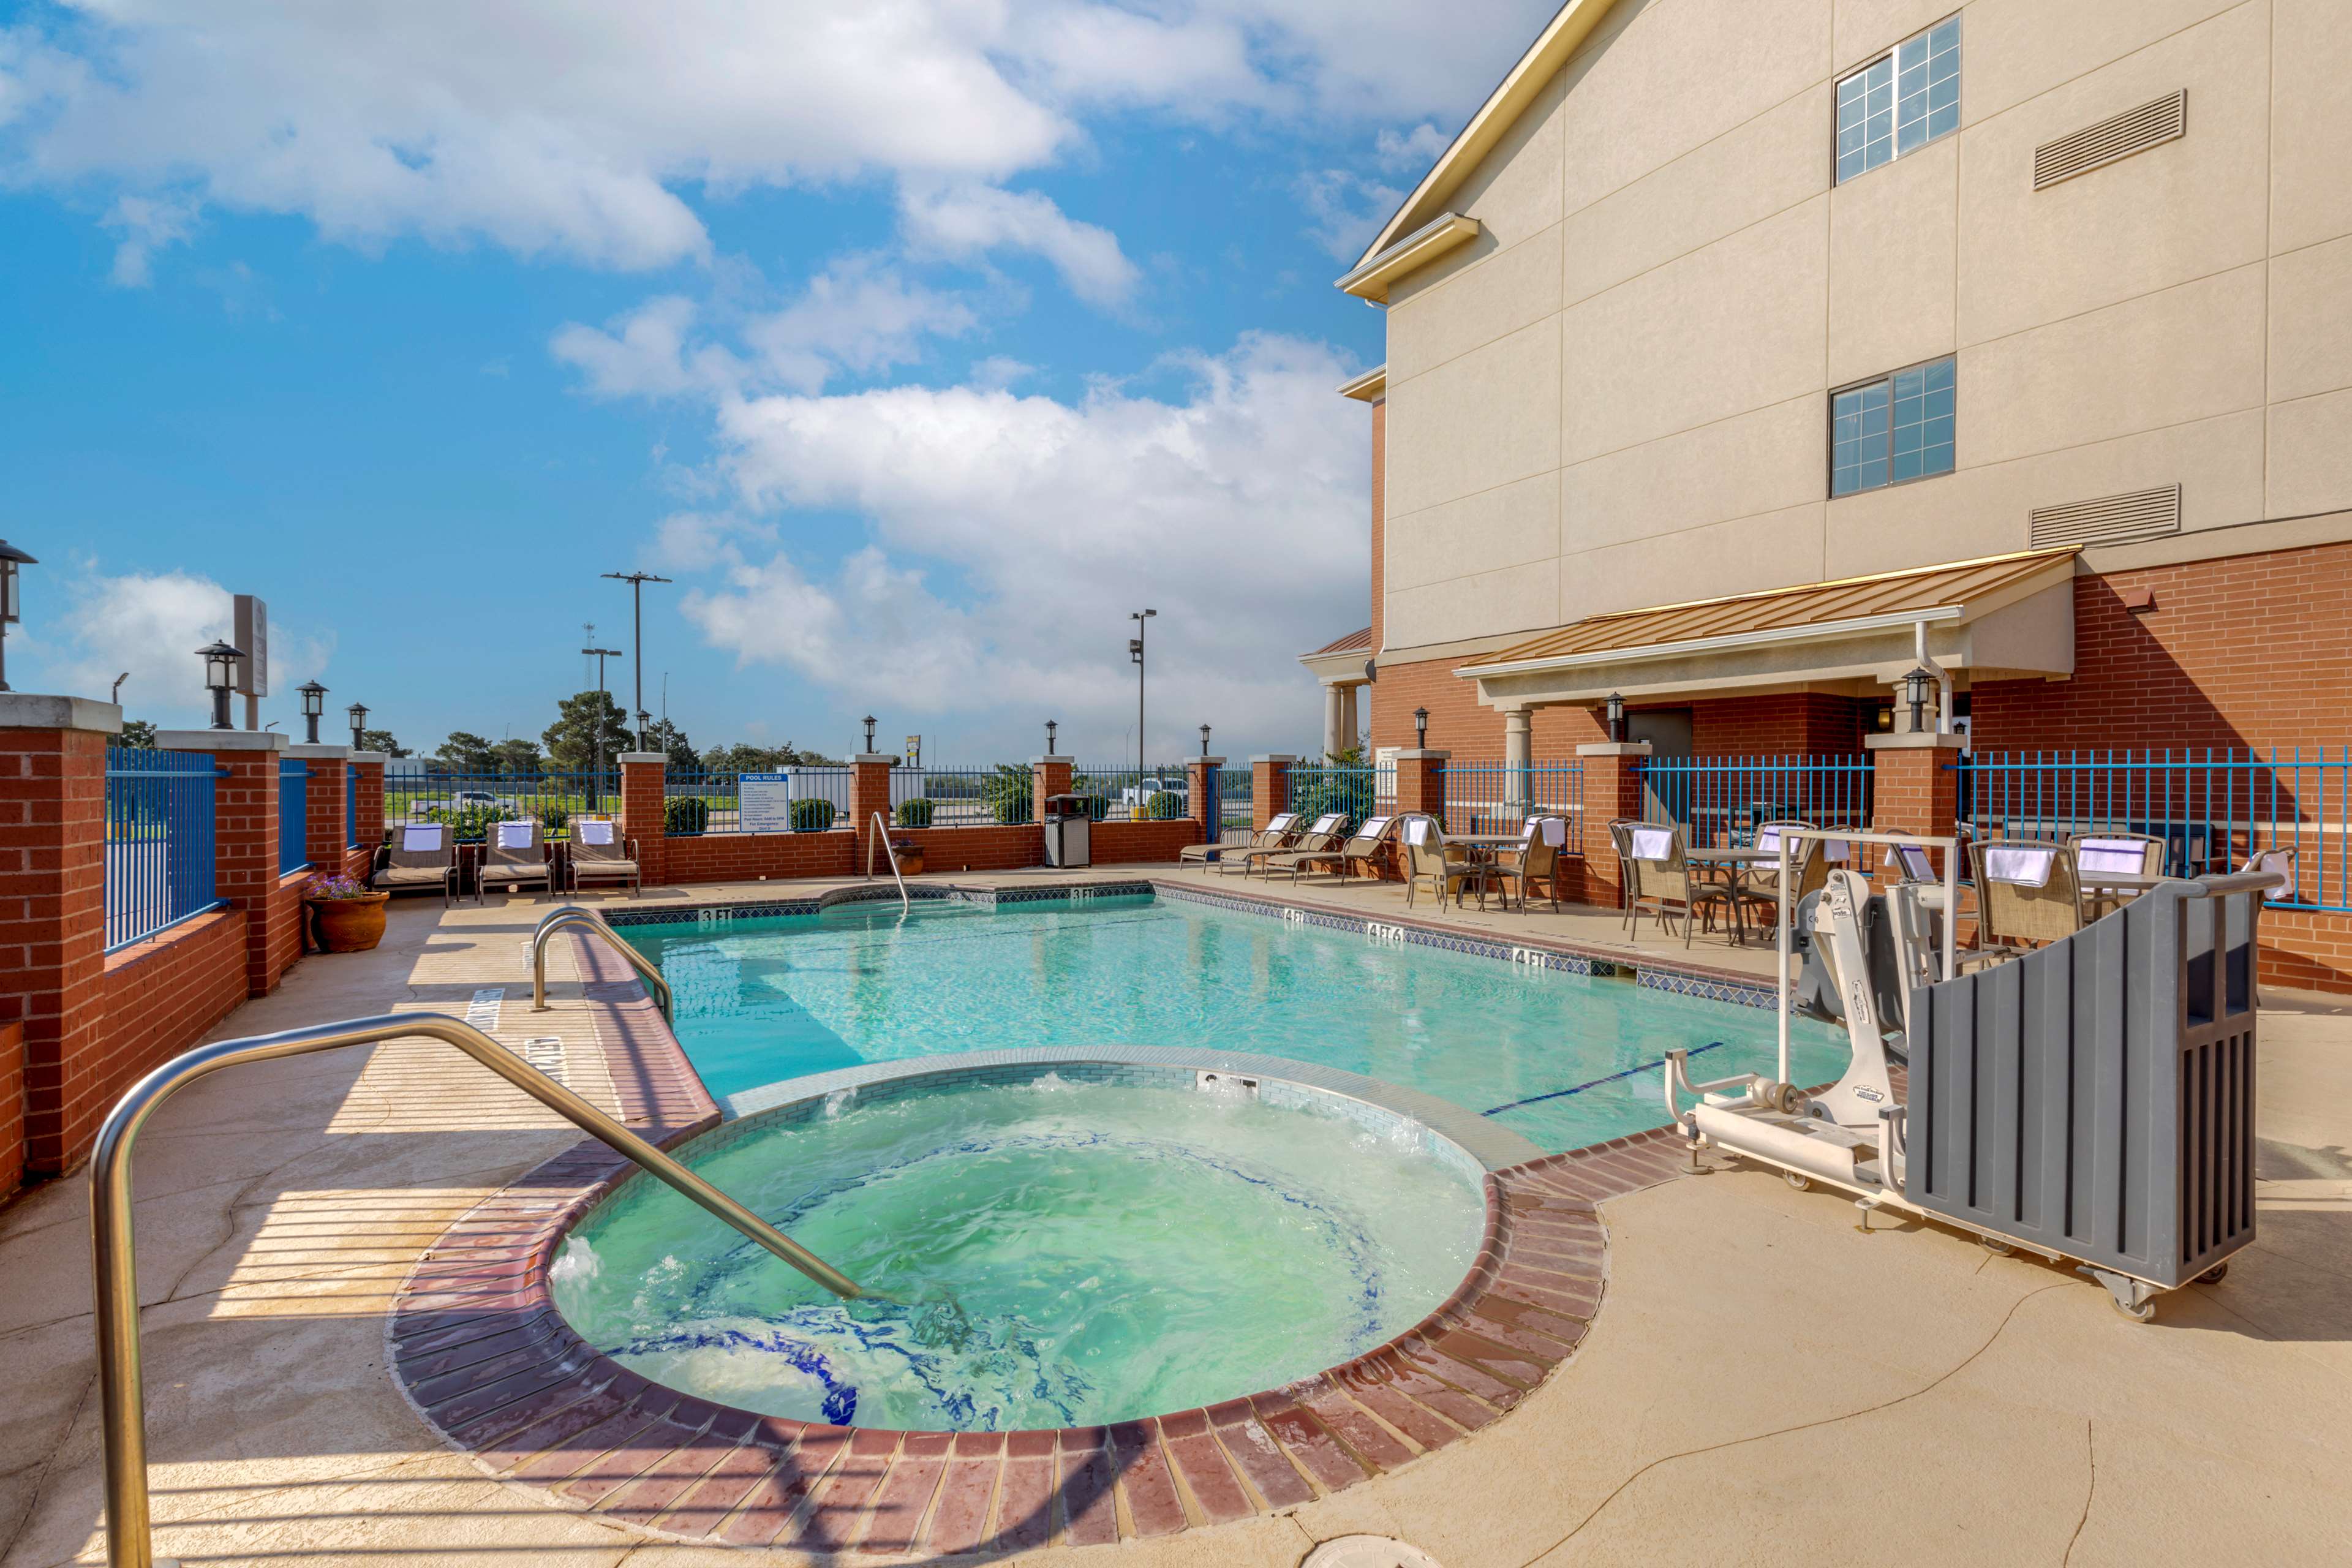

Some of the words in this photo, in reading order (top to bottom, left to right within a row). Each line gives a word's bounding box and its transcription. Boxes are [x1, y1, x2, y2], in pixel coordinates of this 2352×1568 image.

[1073, 889, 1080, 899] 3
[1083, 889, 1093, 898] FT
[703, 910, 711, 921] 3
[716, 910, 731, 920] FT
[1286, 910, 1292, 921] 4
[1294, 911, 1303, 922] FT
[1370, 924, 1377, 936] 4
[1380, 925, 1390, 938] FT
[1393, 929, 1401, 941] 6
[1516, 950, 1525, 963] 4
[1529, 952, 1544, 967] FT
